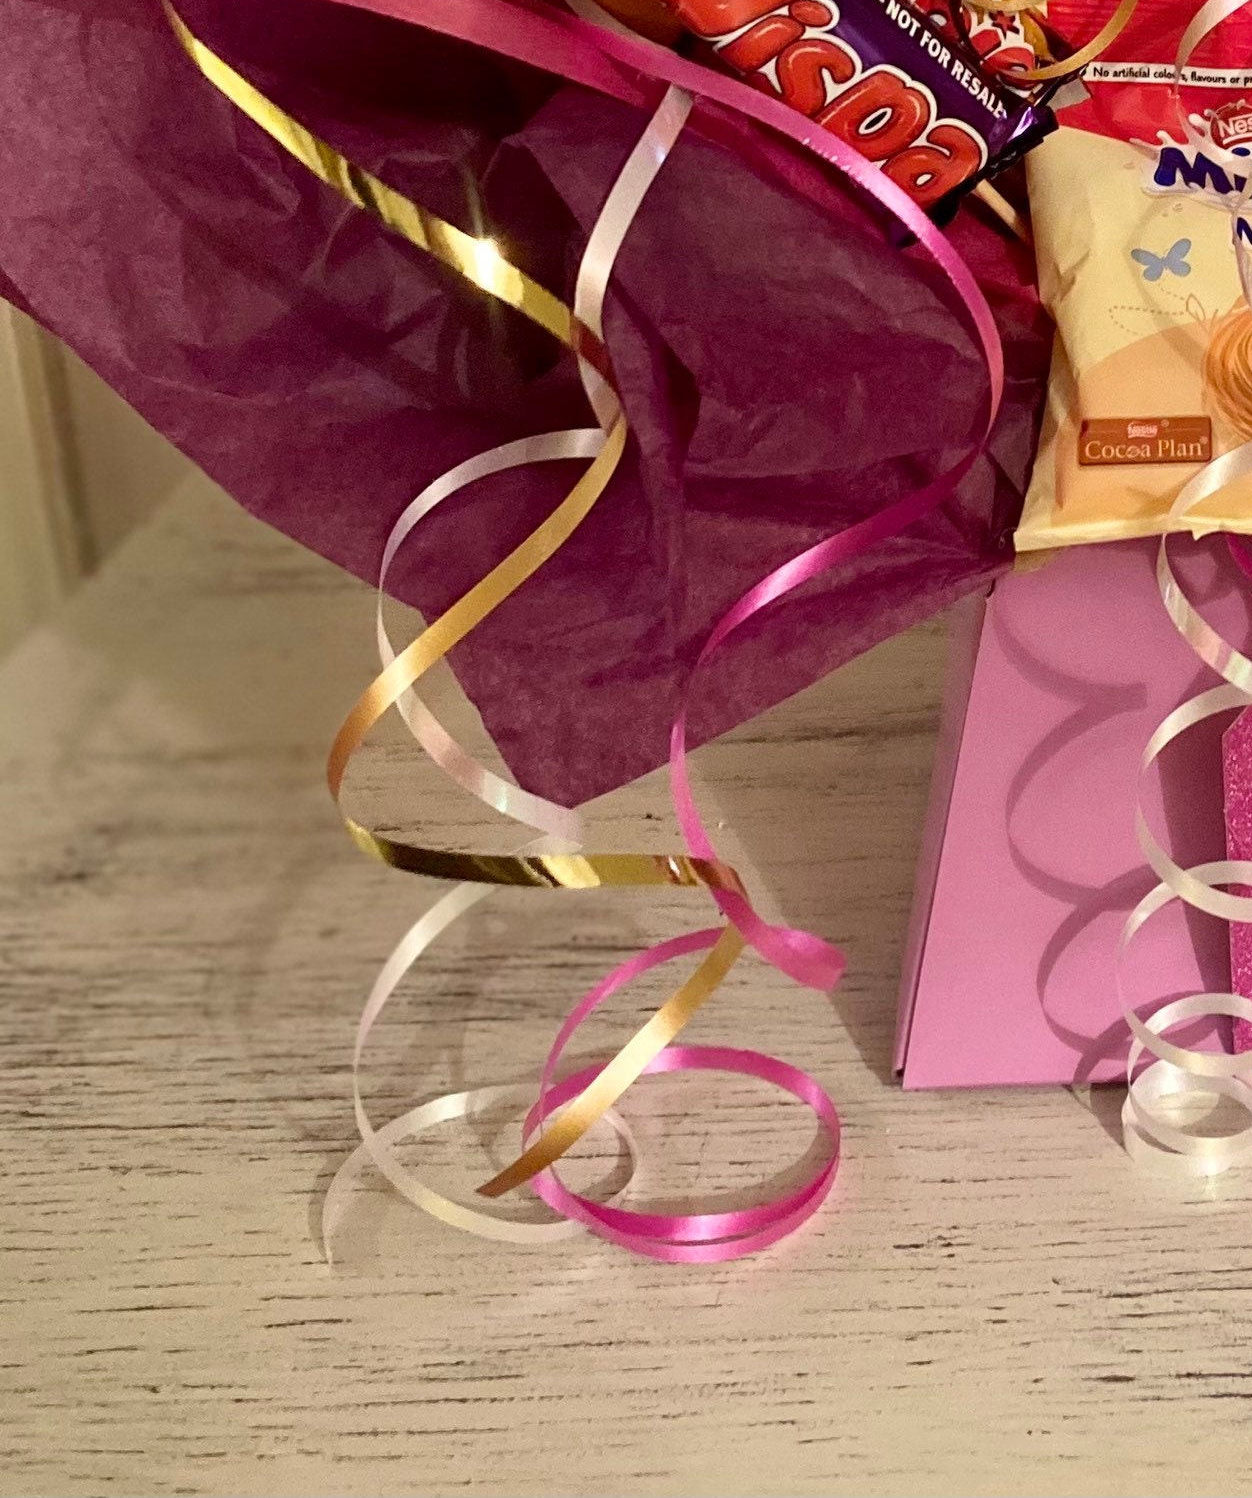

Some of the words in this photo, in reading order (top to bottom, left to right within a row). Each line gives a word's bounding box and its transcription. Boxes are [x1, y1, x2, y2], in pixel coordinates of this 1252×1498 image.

[919, 26, 951, 69] FOR
[950, 57, 1008, 118] RESALE
[1093, 66, 1110, 78] No
[1112, 67, 1151, 79] artificial
[1190, 68, 1227, 84] flavours
[1229, 74, 1240, 84] or
[1085, 440, 1151, 459] Cocoa
[1158, 438, 1203, 458] Plan
